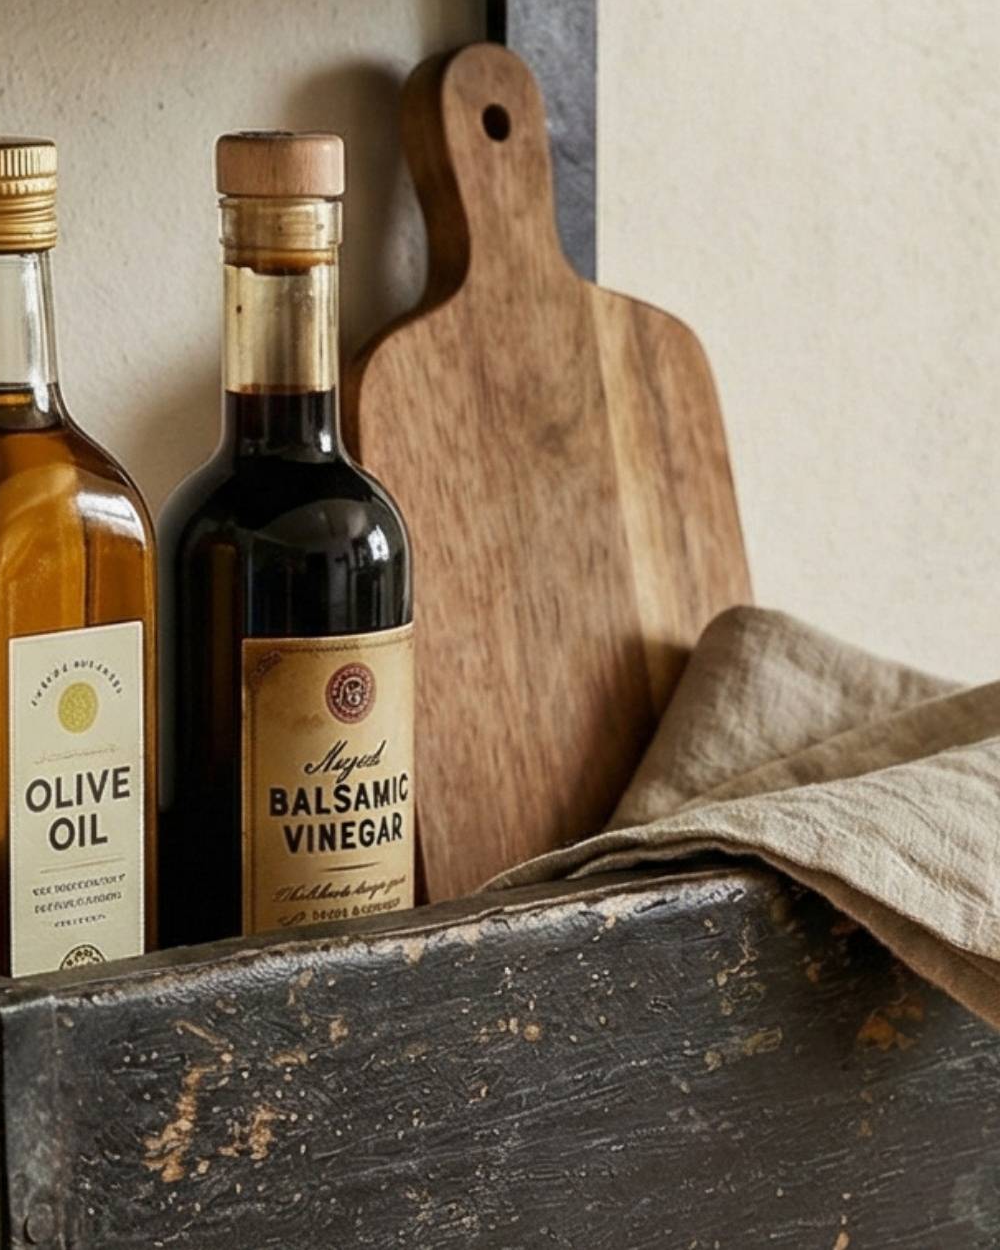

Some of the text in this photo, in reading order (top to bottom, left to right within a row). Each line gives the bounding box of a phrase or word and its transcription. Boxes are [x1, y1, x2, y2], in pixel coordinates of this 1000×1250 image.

[25, 766, 130, 813] OLIVE
[269, 772, 408, 817] BALSAMIC
[49, 813, 108, 851] OIL
[283, 812, 403, 855] VINEGAR
